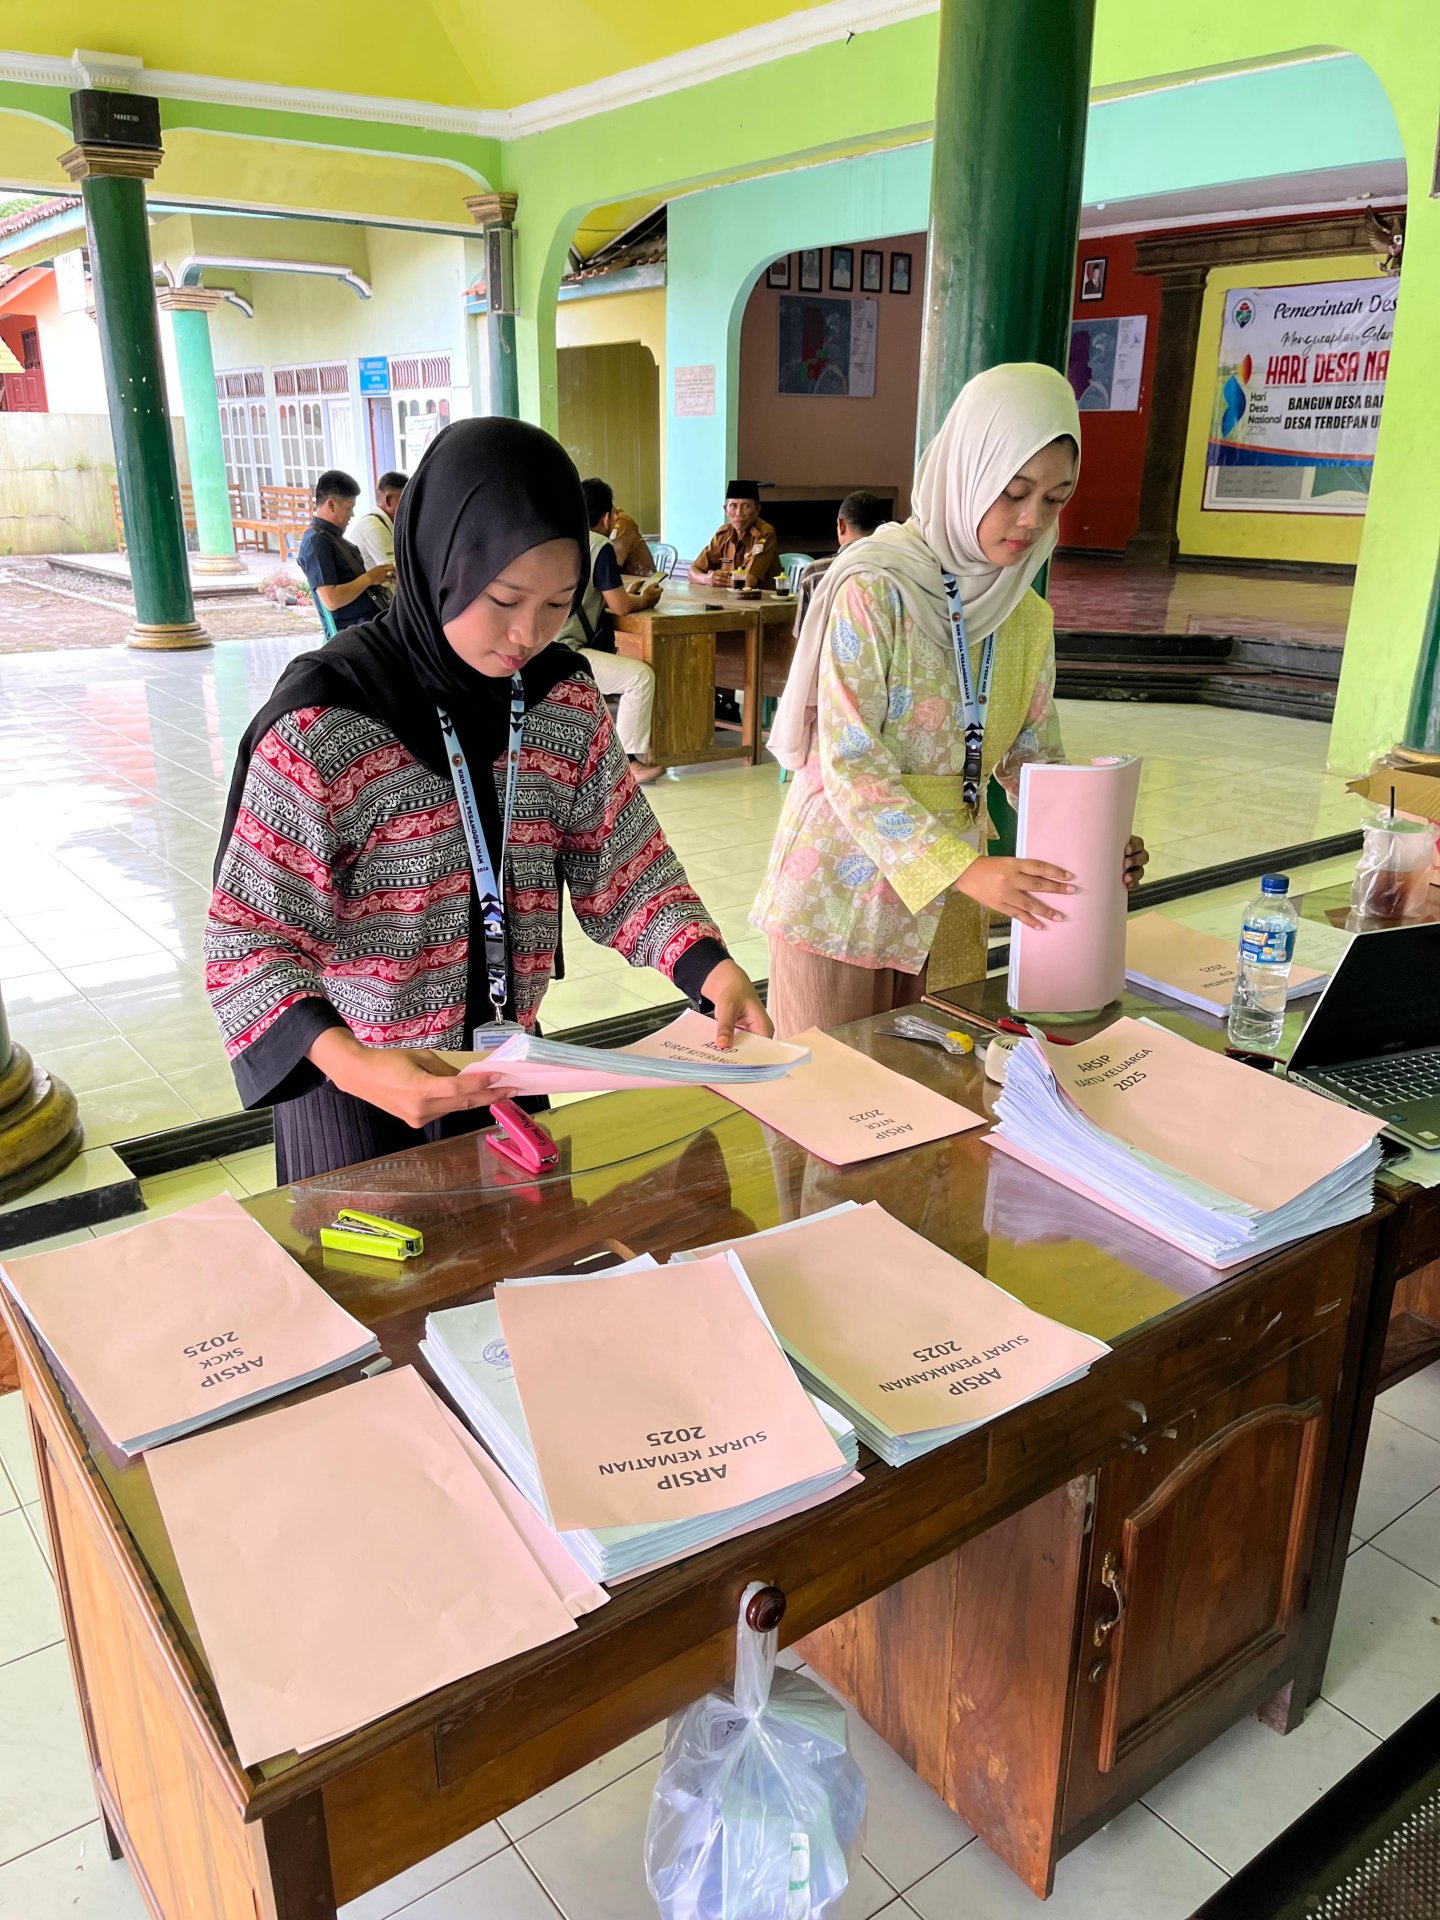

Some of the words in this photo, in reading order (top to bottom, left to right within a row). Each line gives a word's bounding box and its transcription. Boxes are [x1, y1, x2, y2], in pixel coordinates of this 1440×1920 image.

[1274, 298, 1364, 319] Pemerintah
[1265, 355, 1309, 385] HARI
[1313, 351, 1360, 383] DESA
[1363, 350, 1390, 382] NA
[1250, 391, 1268, 402] Hari
[1288, 397, 1334, 411] BANGUN
[1334, 395, 1362, 410] DESA
[1249, 403, 1269, 413] Desa
[1247, 414, 1283, 424] Nasional
[1284, 416, 1311, 430] DESA
[1315, 415, 1367, 430] TERDEPAN
[457, 769, 466, 784] KKN
[461, 786, 470, 804] DESA
[1074, 1075, 1105, 1087] KARTU
[1102, 1048, 1153, 1079] KELUARGA
[1077, 1054, 1111, 1073] ARSIP
[1113, 1070, 1147, 1091] 2025
[849, 1109, 884, 1123] 2025
[865, 1118, 896, 1130] NTCR
[876, 1123, 914, 1140] ARSIP
[183, 1331, 239, 1358] 2025
[912, 1340, 962, 1363] 2025
[985, 1335, 1030, 1361] SURAT
[198, 1347, 245, 1370] SKCK
[201, 1355, 264, 1388] ARSIP
[878, 1355, 982, 1393] PEMAKAMAN
[948, 1367, 1003, 1396] ARSIP
[646, 1425, 706, 1447] 2025
[707, 1431, 768, 1458] SURAT
[598, 1450, 702, 1476] KEMATIAN
[657, 1463, 727, 1490] ARSIP
